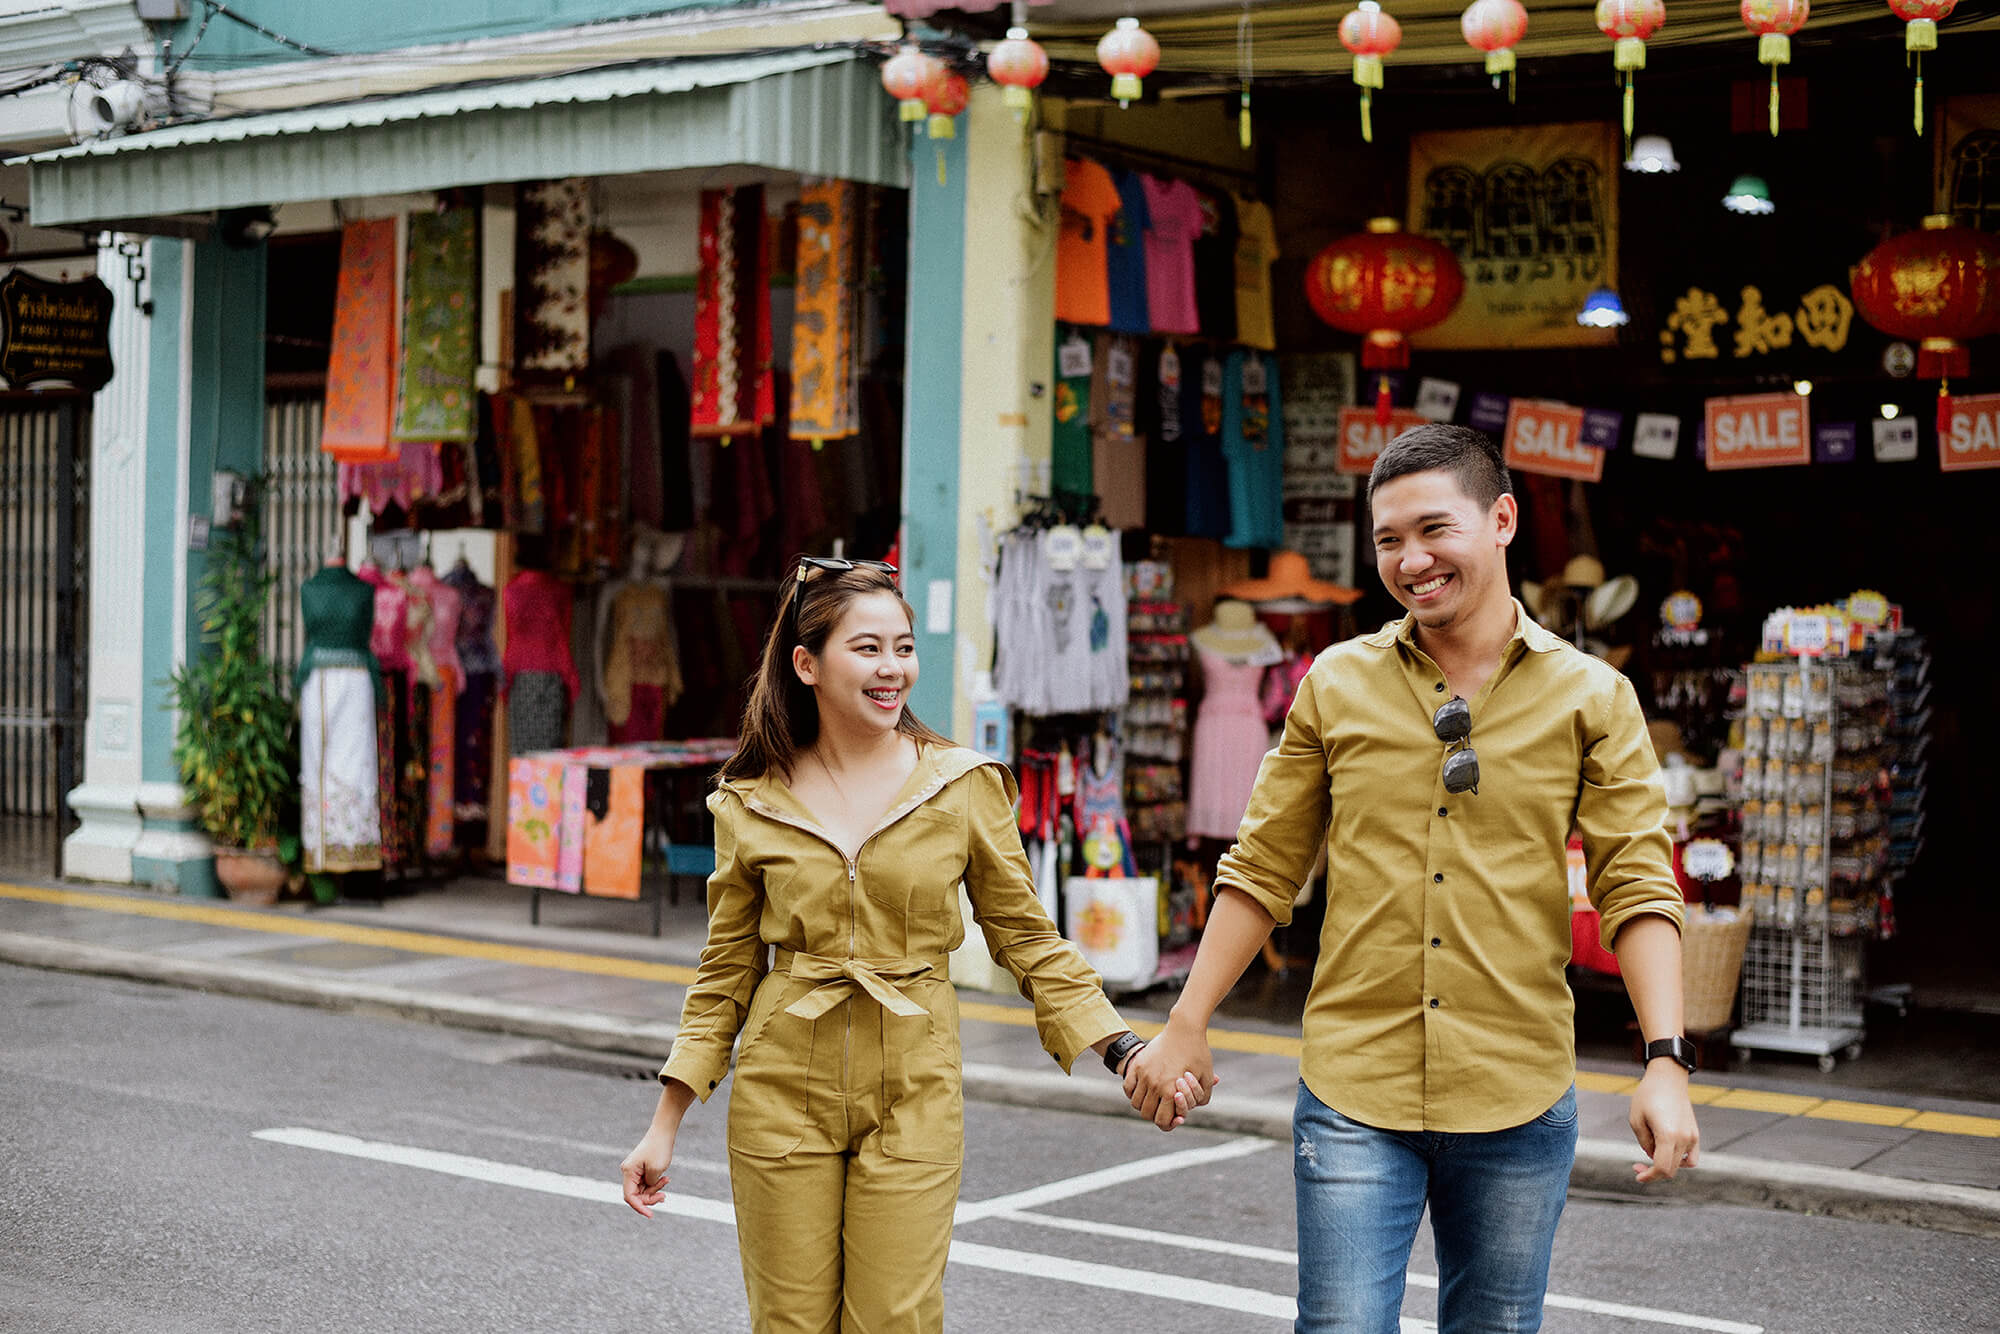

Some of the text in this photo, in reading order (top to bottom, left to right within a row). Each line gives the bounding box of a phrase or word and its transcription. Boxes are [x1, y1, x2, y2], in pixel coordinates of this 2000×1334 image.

[1346, 421, 1422, 459] SA
[1715, 409, 1800, 454] SALE
[1949, 411, 2000, 454] SA
